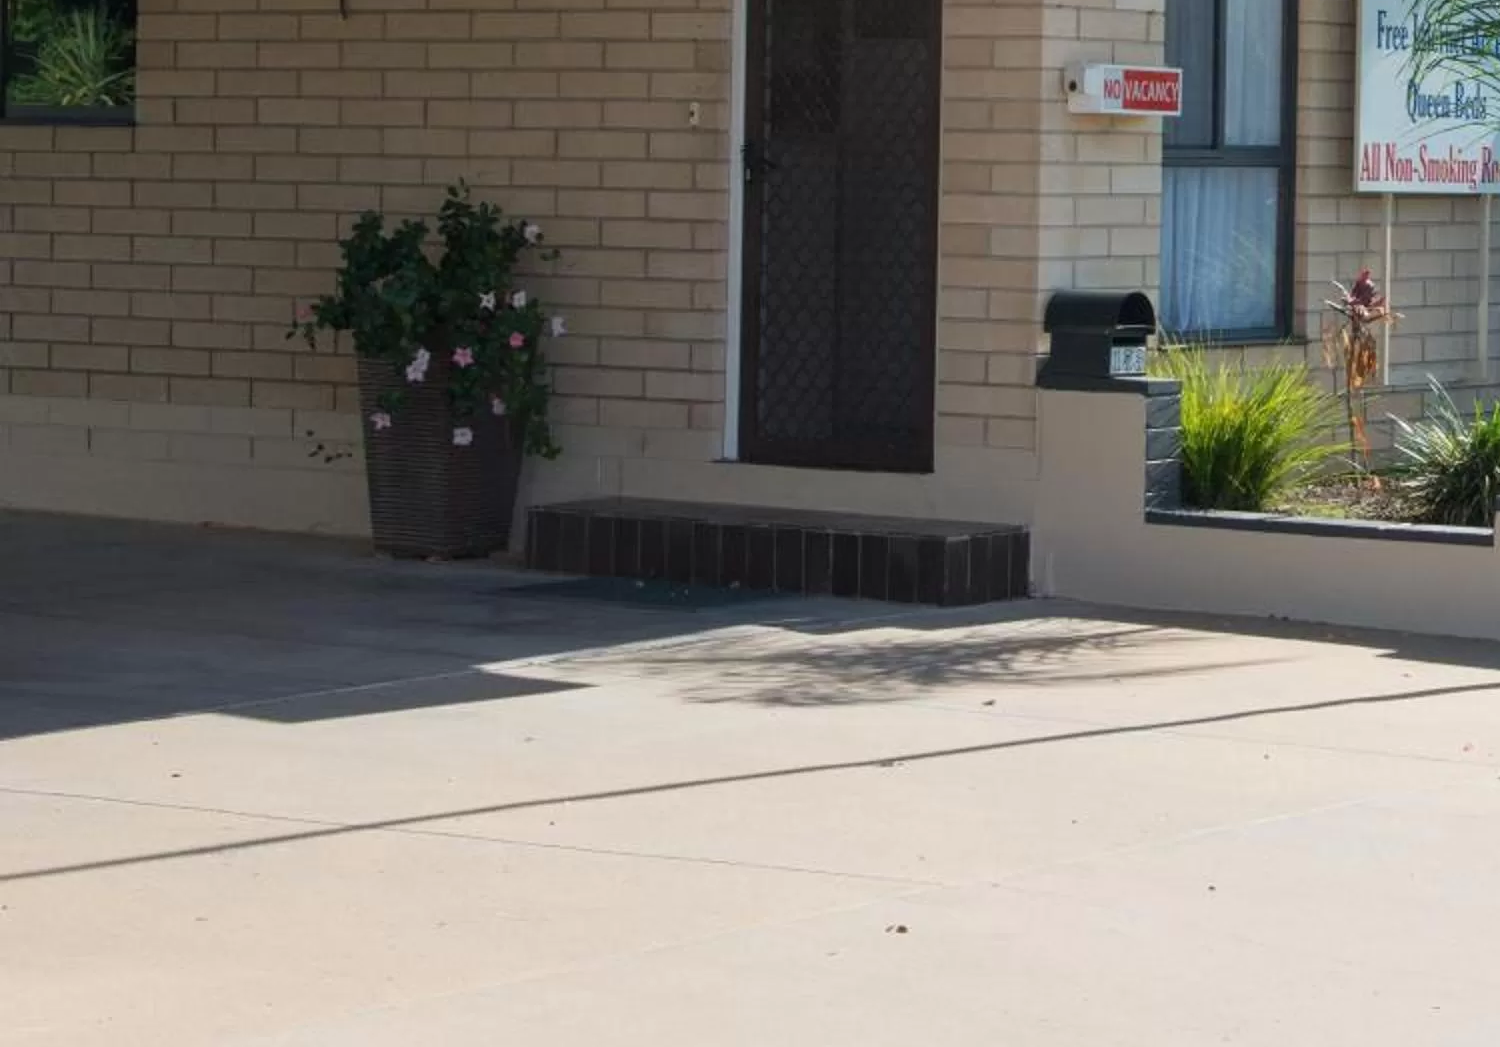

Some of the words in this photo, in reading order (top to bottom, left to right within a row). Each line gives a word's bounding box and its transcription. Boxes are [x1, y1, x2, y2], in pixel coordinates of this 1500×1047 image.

[1377, 10, 1409, 51] Free
[1104, 79, 1121, 99] NO
[1124, 79, 1179, 102] VACANCY
[1407, 79, 1450, 123] Queen
[1455, 81, 1487, 120] Beds
[1360, 142, 1381, 182] All
[1385, 142, 1478, 189] Non-Smoking
